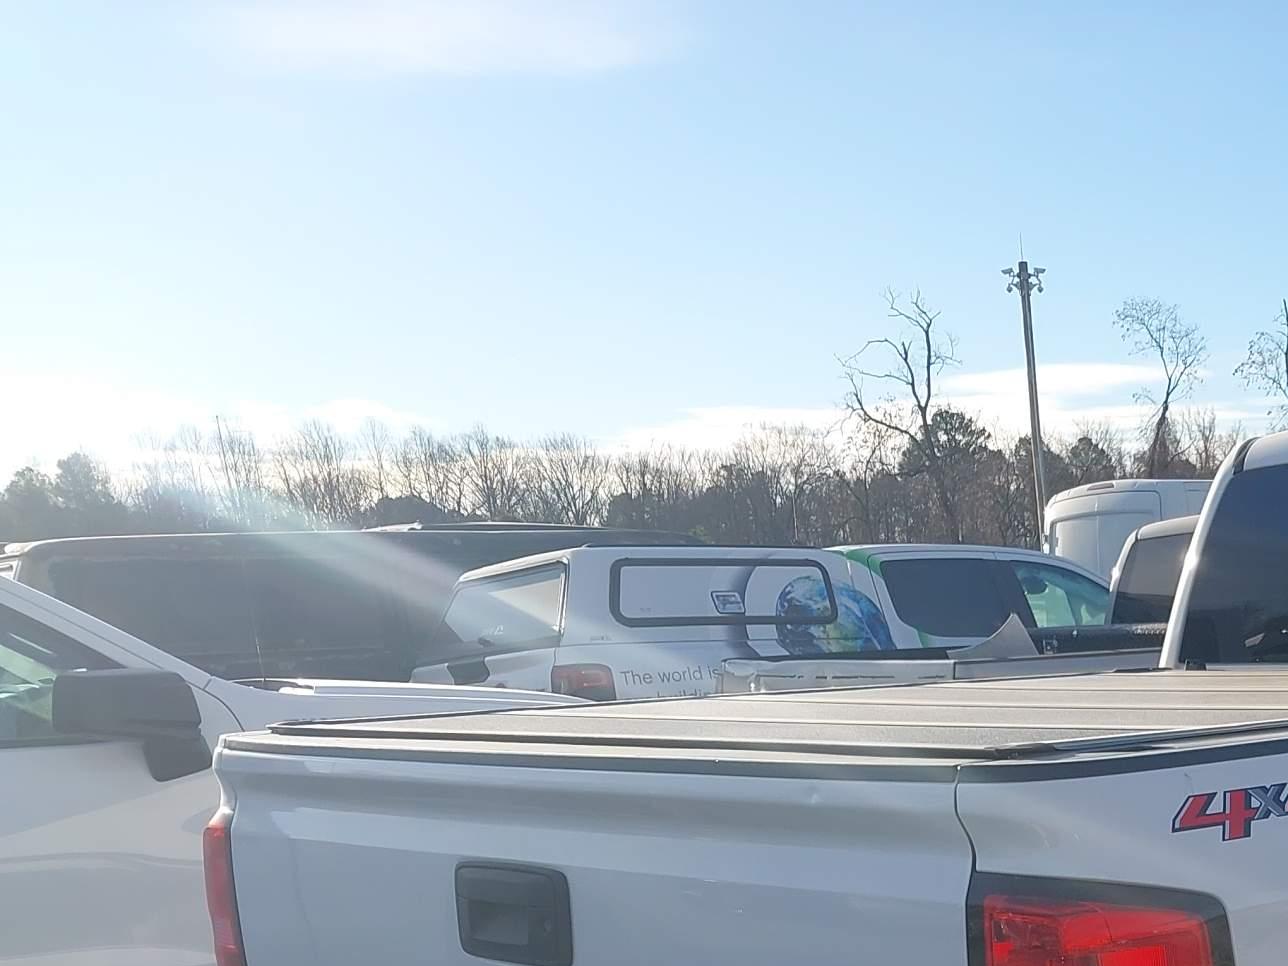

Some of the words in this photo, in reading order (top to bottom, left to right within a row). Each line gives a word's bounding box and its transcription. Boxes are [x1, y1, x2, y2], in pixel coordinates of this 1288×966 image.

[620, 670, 653, 686] The
[658, 665, 703, 683] world
[707, 663, 720, 680] is
